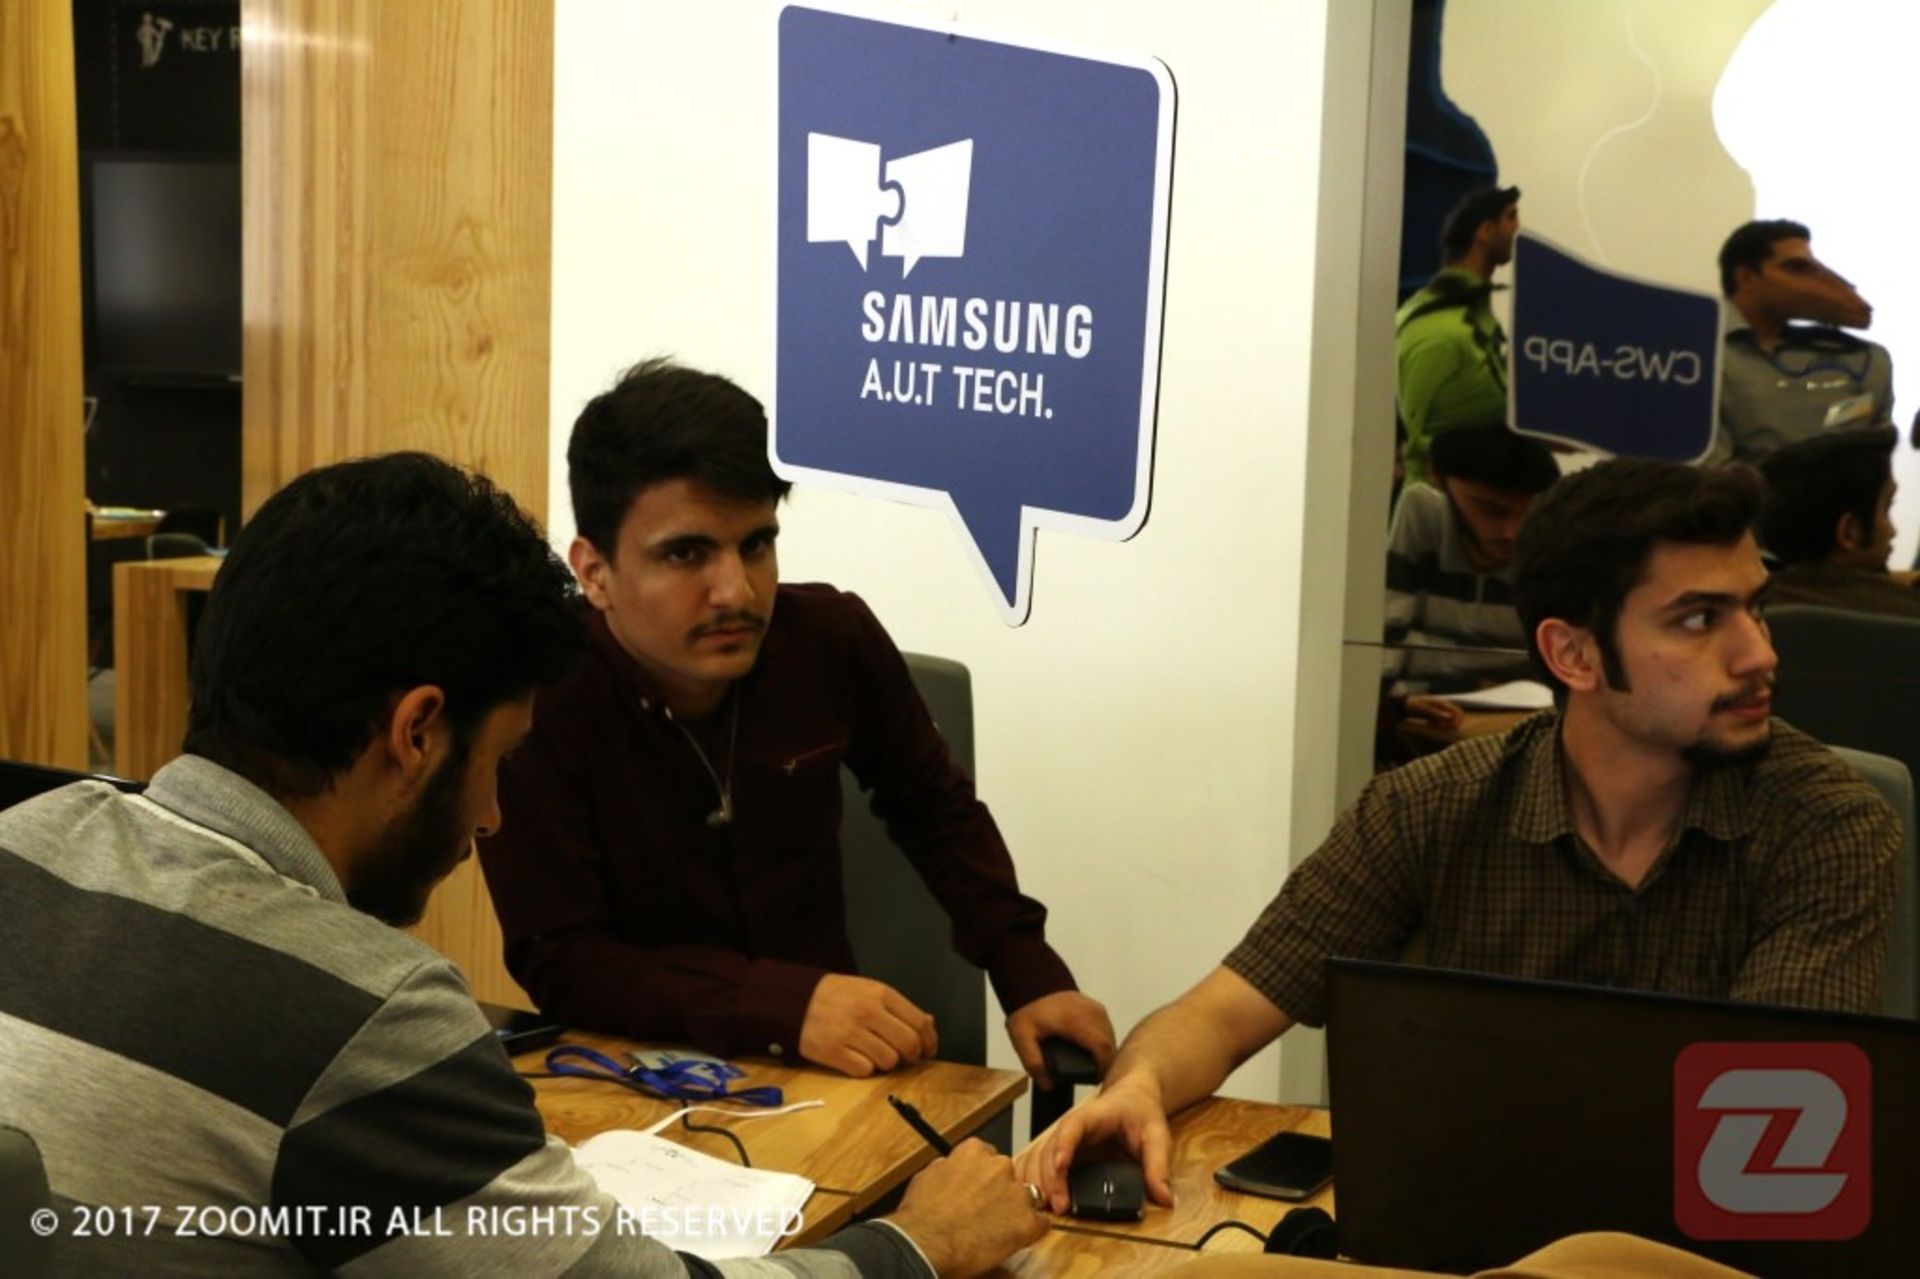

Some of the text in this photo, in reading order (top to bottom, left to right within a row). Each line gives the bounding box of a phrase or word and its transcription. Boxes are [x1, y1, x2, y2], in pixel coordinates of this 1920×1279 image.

[181, 28, 223, 51] KEY
[862, 291, 1093, 359] SAMSUNG
[860, 358, 1053, 419] A.U.T TECH.
